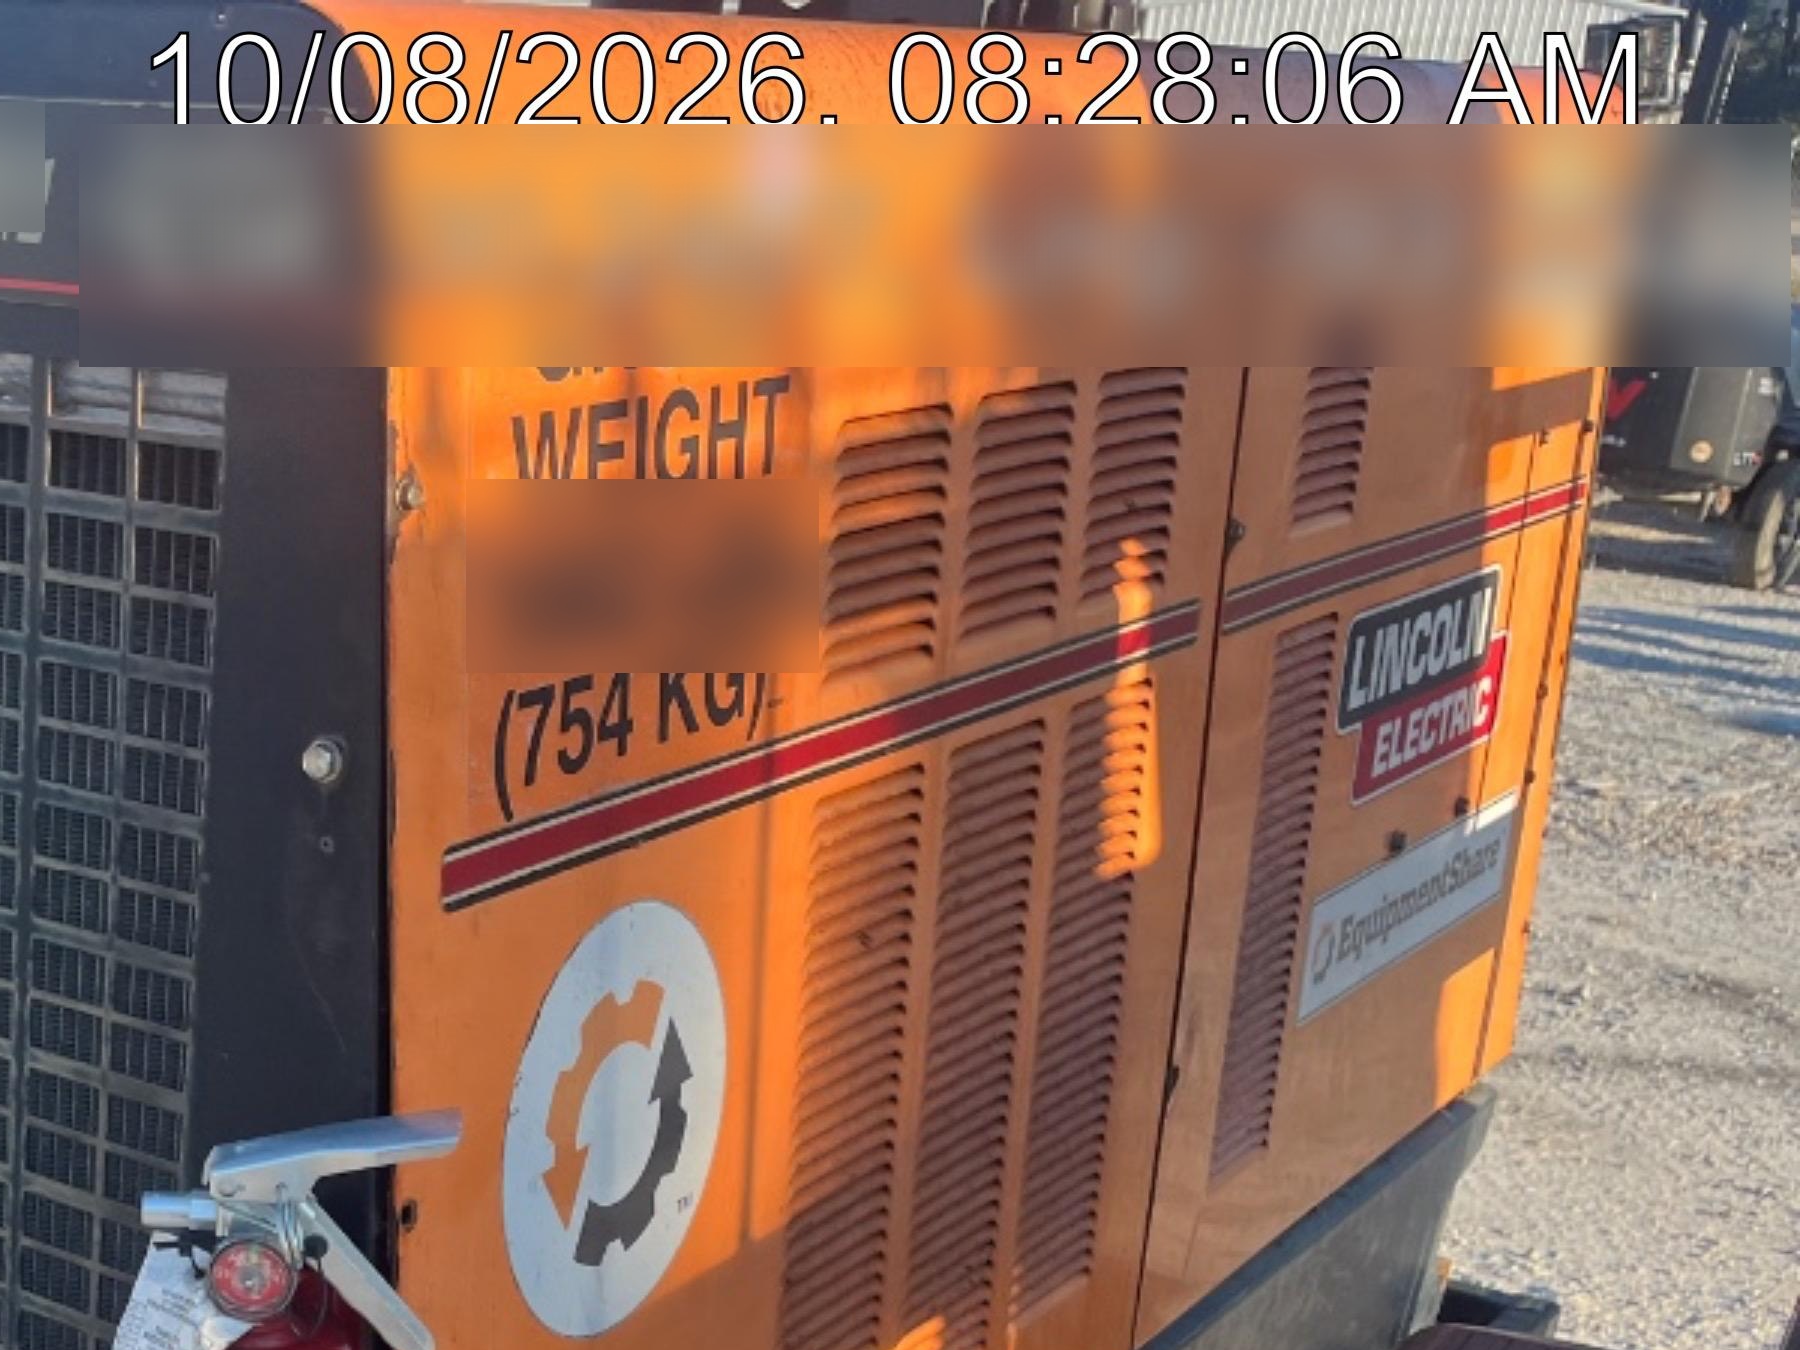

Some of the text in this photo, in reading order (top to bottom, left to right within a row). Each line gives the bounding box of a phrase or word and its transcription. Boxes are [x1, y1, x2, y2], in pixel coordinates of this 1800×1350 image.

[511, 374, 791, 479] WEIGHT
[1346, 586, 1493, 713] LINCOLN
[494, 672, 634, 822] (754
[1370, 675, 1493, 779] ELECTRIC
[1335, 838, 1501, 963] EquipmentShare
